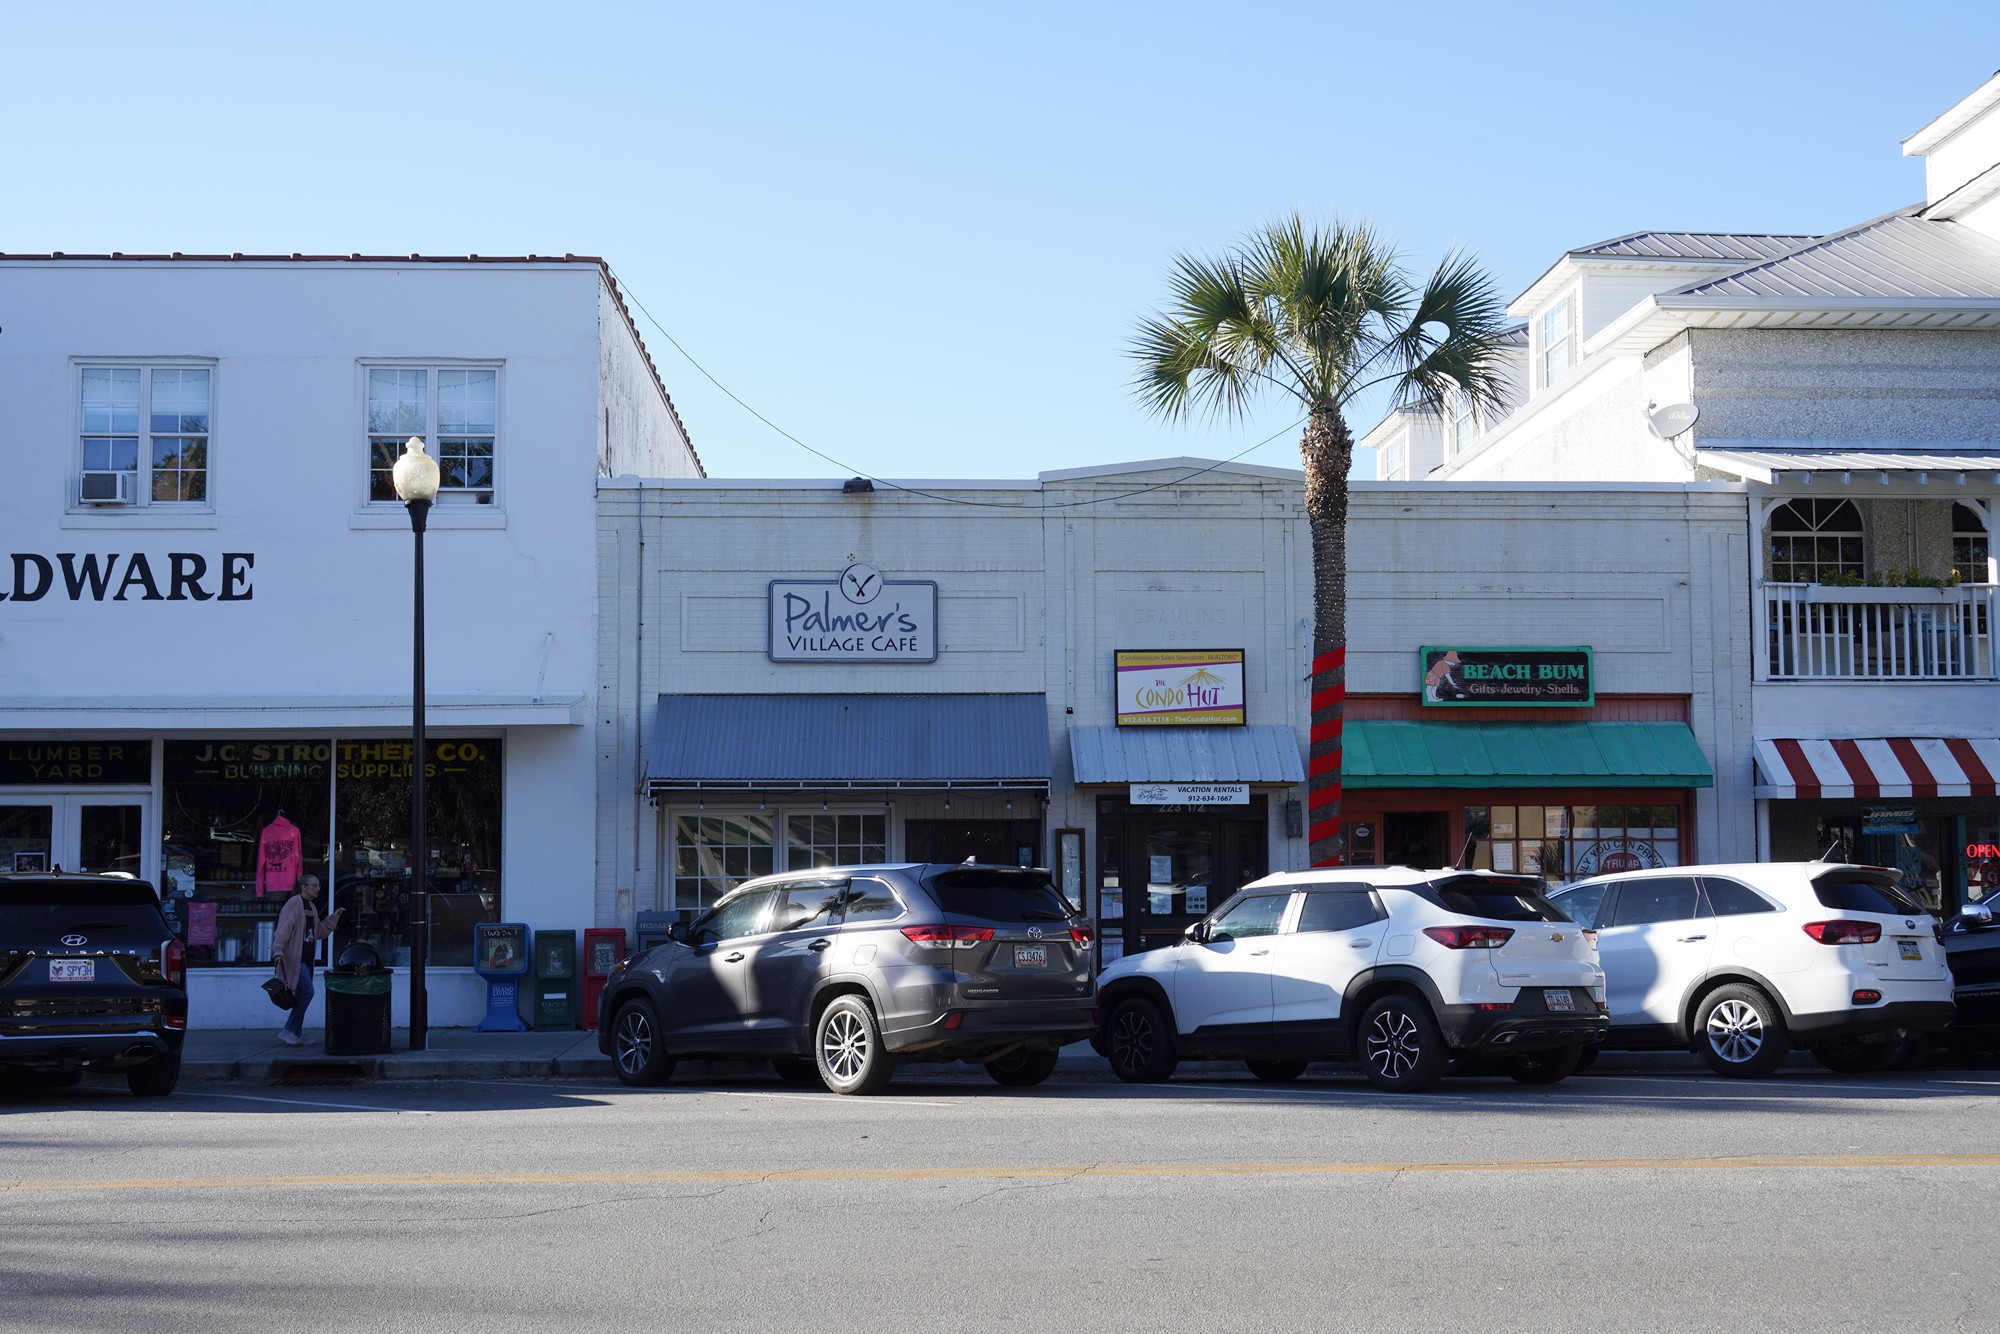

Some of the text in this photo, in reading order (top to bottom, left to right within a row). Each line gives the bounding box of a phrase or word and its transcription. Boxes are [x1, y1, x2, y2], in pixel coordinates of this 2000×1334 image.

[0, 553, 254, 601] DWARE
[783, 590, 917, 634] Palmer's
[787, 635, 917, 651] VILLAGE CAFÉ
[1176, 653, 1204, 662] Specialists
[1463, 664, 1585, 680] BEACH BUM
[1135, 686, 1184, 709] CONDO
[1470, 683, 1579, 696] Gifts Jewelry Shells
[1174, 715, 1238, 723] TheCondoHut.com
[8, 746, 125, 761] LUMBER
[435, 742, 487, 762] CO.
[29, 764, 104, 778] YARD
[336, 763, 437, 779] SUPPLIS
[1863, 810, 1915, 819] JAMIS
[1590, 841, 1611, 858] YOU
[1606, 858, 1640, 869] TRUMP
